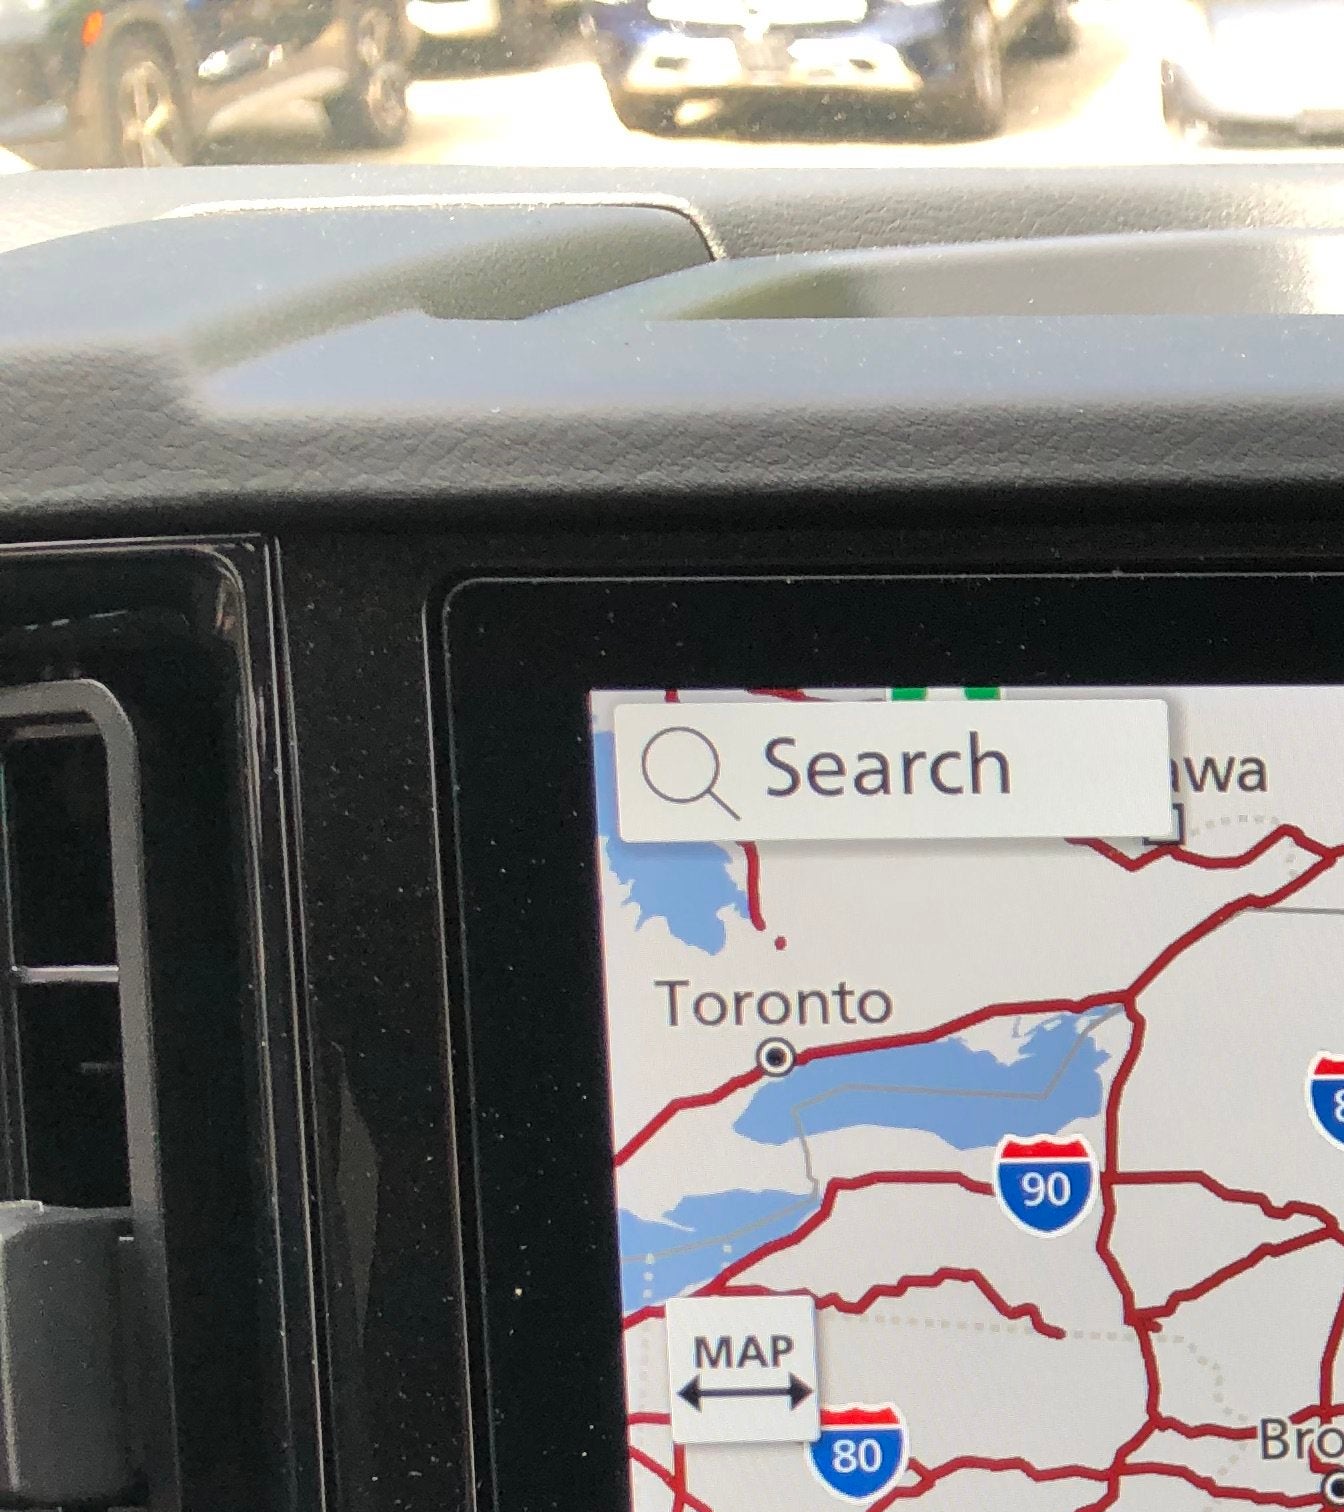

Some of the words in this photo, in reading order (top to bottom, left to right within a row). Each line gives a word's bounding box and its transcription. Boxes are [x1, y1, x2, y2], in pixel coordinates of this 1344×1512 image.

[763, 731, 1012, 800] Search
[654, 980, 893, 1027] Toronto
[1021, 1171, 1072, 1206] 90
[694, 1335, 795, 1370] MAP
[832, 1438, 882, 1474] 80
